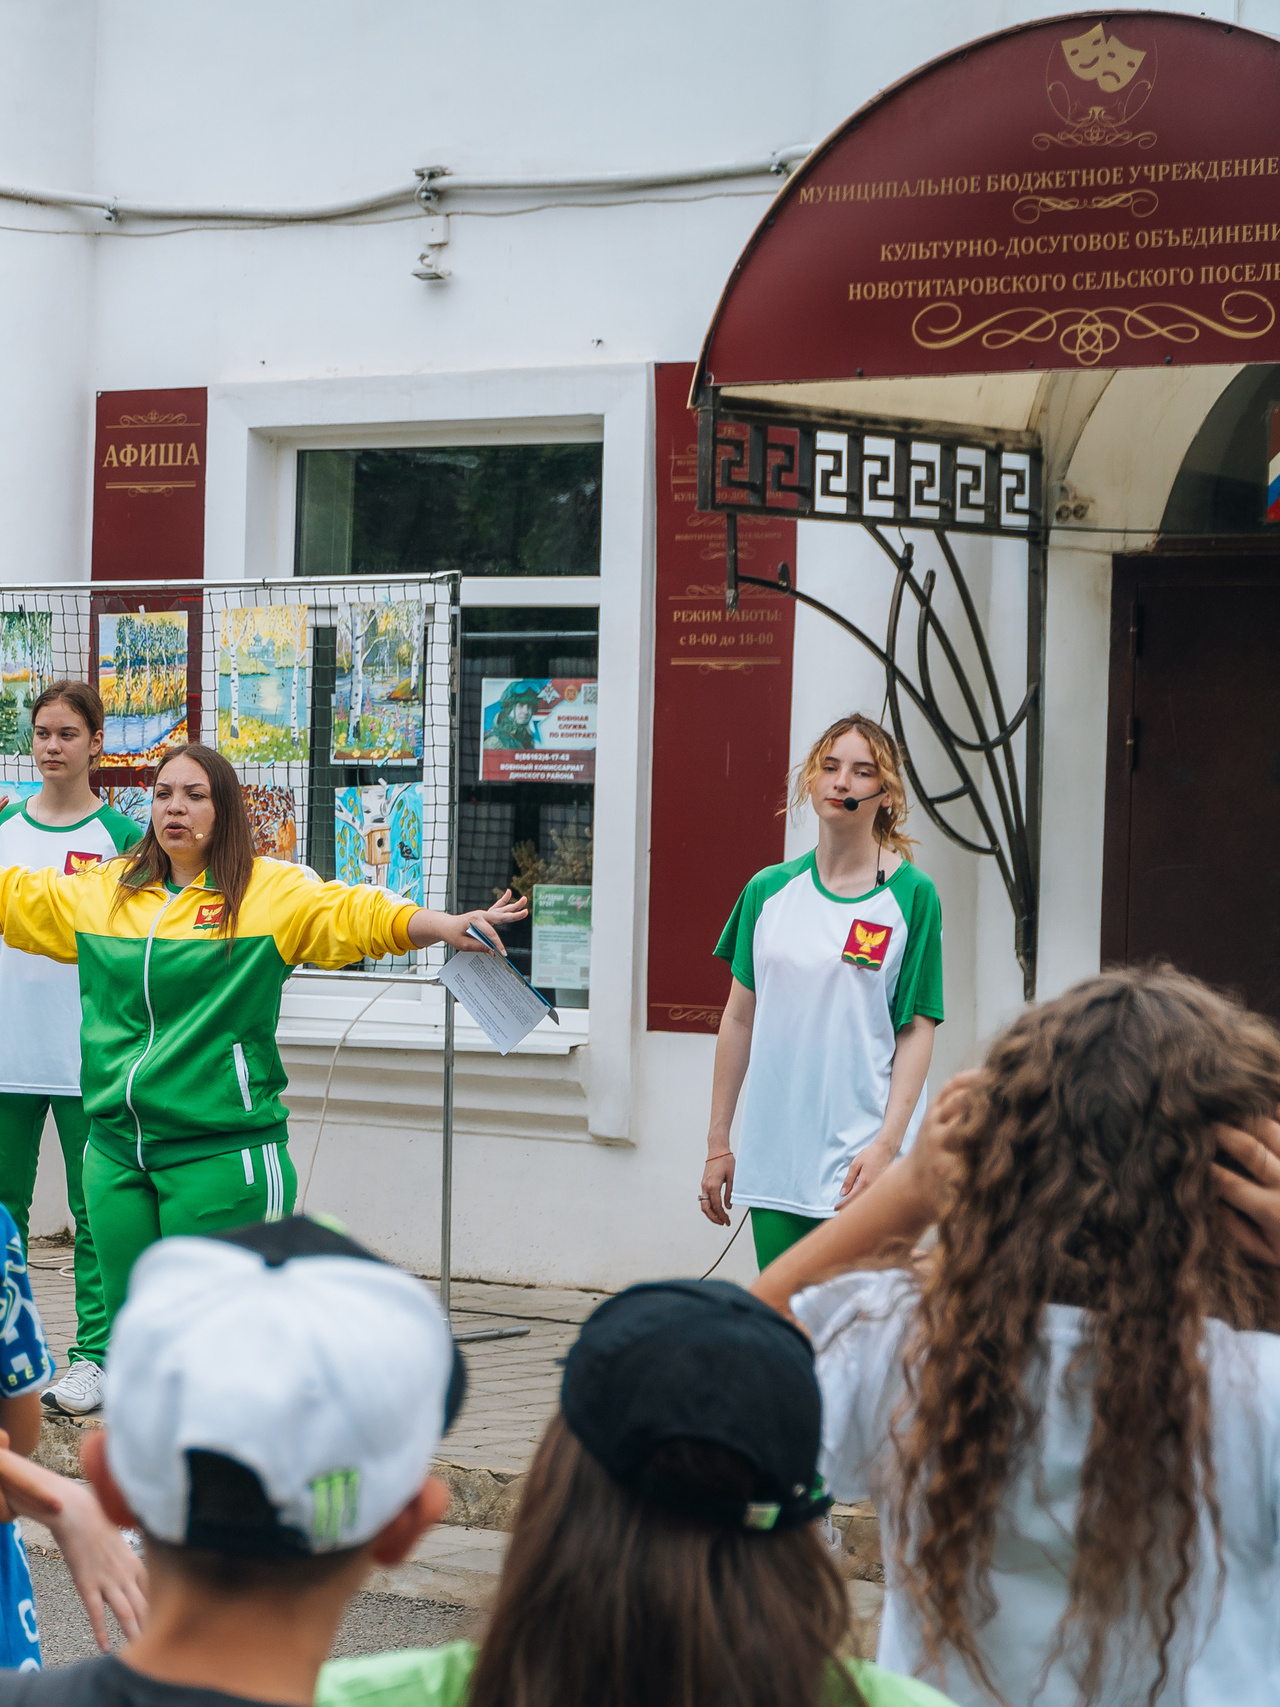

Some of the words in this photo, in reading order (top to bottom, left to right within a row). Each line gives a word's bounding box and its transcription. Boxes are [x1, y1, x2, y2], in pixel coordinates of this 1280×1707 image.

[799, 174, 981, 204] МУНИЦИПАЛЬНОЕ
[986, 164, 1124, 194] БЮДЖЕТНОЕ
[1128, 156, 1279, 185] УЧРЕЖДЕНИЕ
[880, 230, 1130, 262] КУЛЬТУРНО-ДОСУГОВОЕ
[848, 271, 1066, 300] НОВОТИТАРОВСКОГО
[1072, 266, 1194, 291] СЕЛЬСКОГО
[102, 442, 201, 468] АФИША
[673, 609, 722, 623] РЕЖИМ
[679, 635, 687, 646] с
[688, 632, 717, 645] 8-00
[719, 634, 736, 647] до
[739, 631, 774, 645] 18-00
